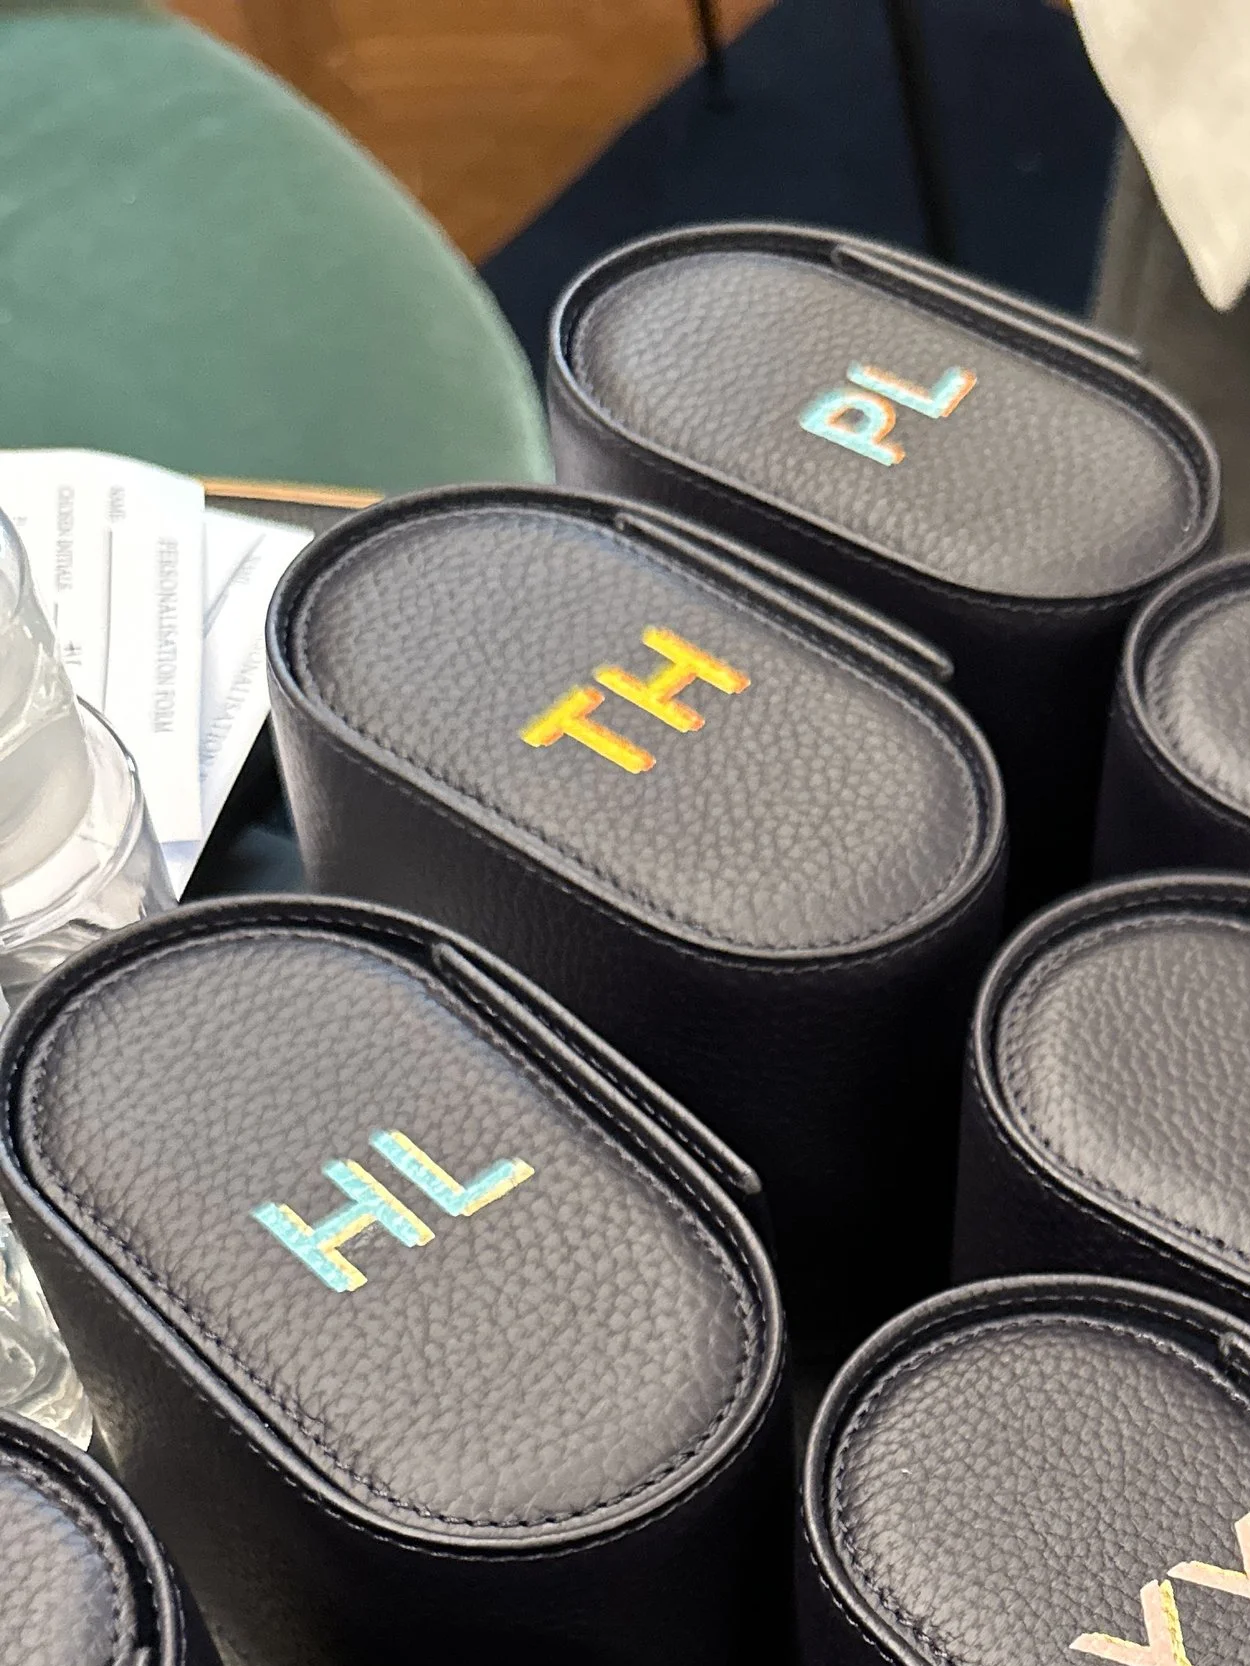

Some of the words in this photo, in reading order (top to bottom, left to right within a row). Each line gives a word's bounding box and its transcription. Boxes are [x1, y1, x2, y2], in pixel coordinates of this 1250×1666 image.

[795, 360, 978, 466] PL
[154, 537, 179, 686] PERSONALISATION
[152, 689, 176, 734] FORM
[520, 626, 750, 774] TH
[250, 1128, 533, 1295] HL
